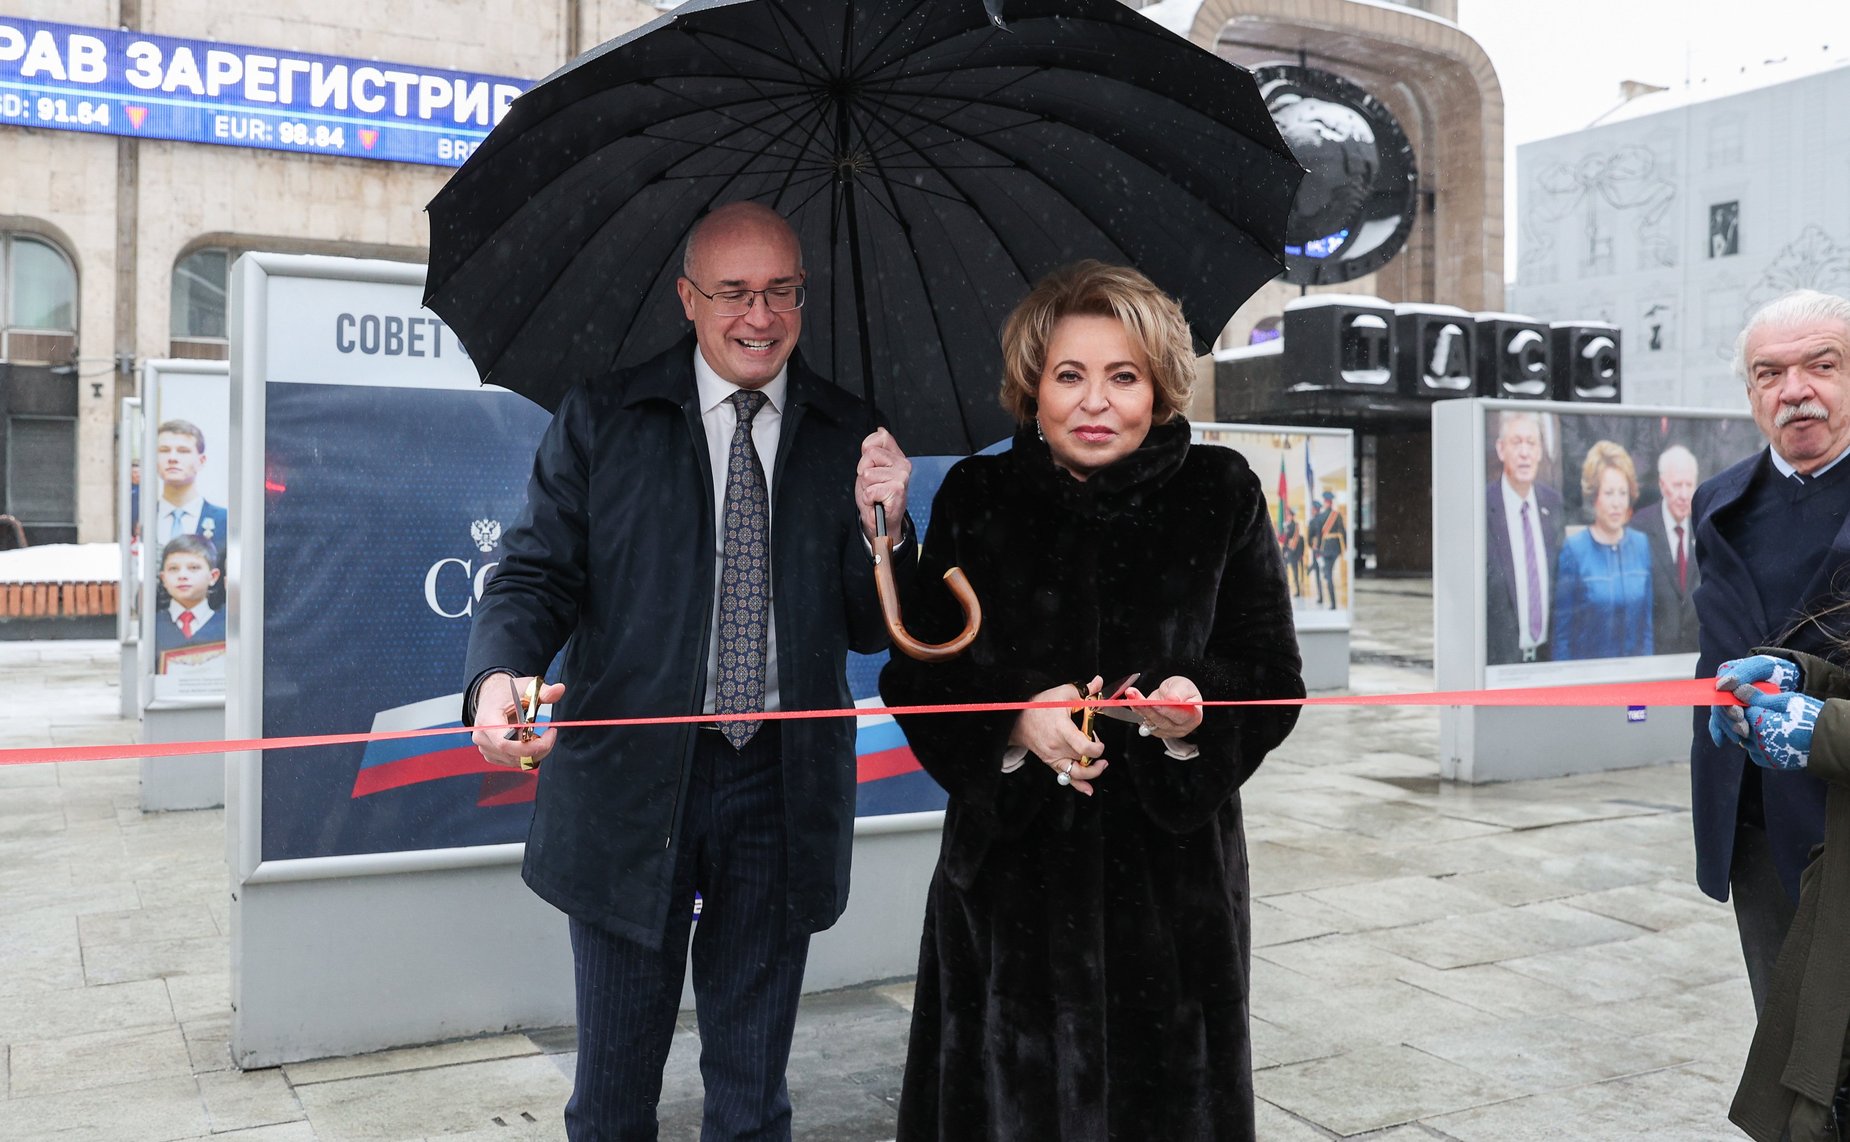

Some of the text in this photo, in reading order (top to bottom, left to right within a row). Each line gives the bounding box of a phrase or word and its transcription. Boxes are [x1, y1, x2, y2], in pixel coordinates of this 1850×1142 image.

[0, 93, 30, 119] D:
[37, 97, 110, 127] 91.64
[215, 115, 273, 141] EUR:
[279, 121, 345, 149] 98.84
[336, 312, 446, 358] СОВЕТ
[1341, 313, 1617, 394] ТАСС
